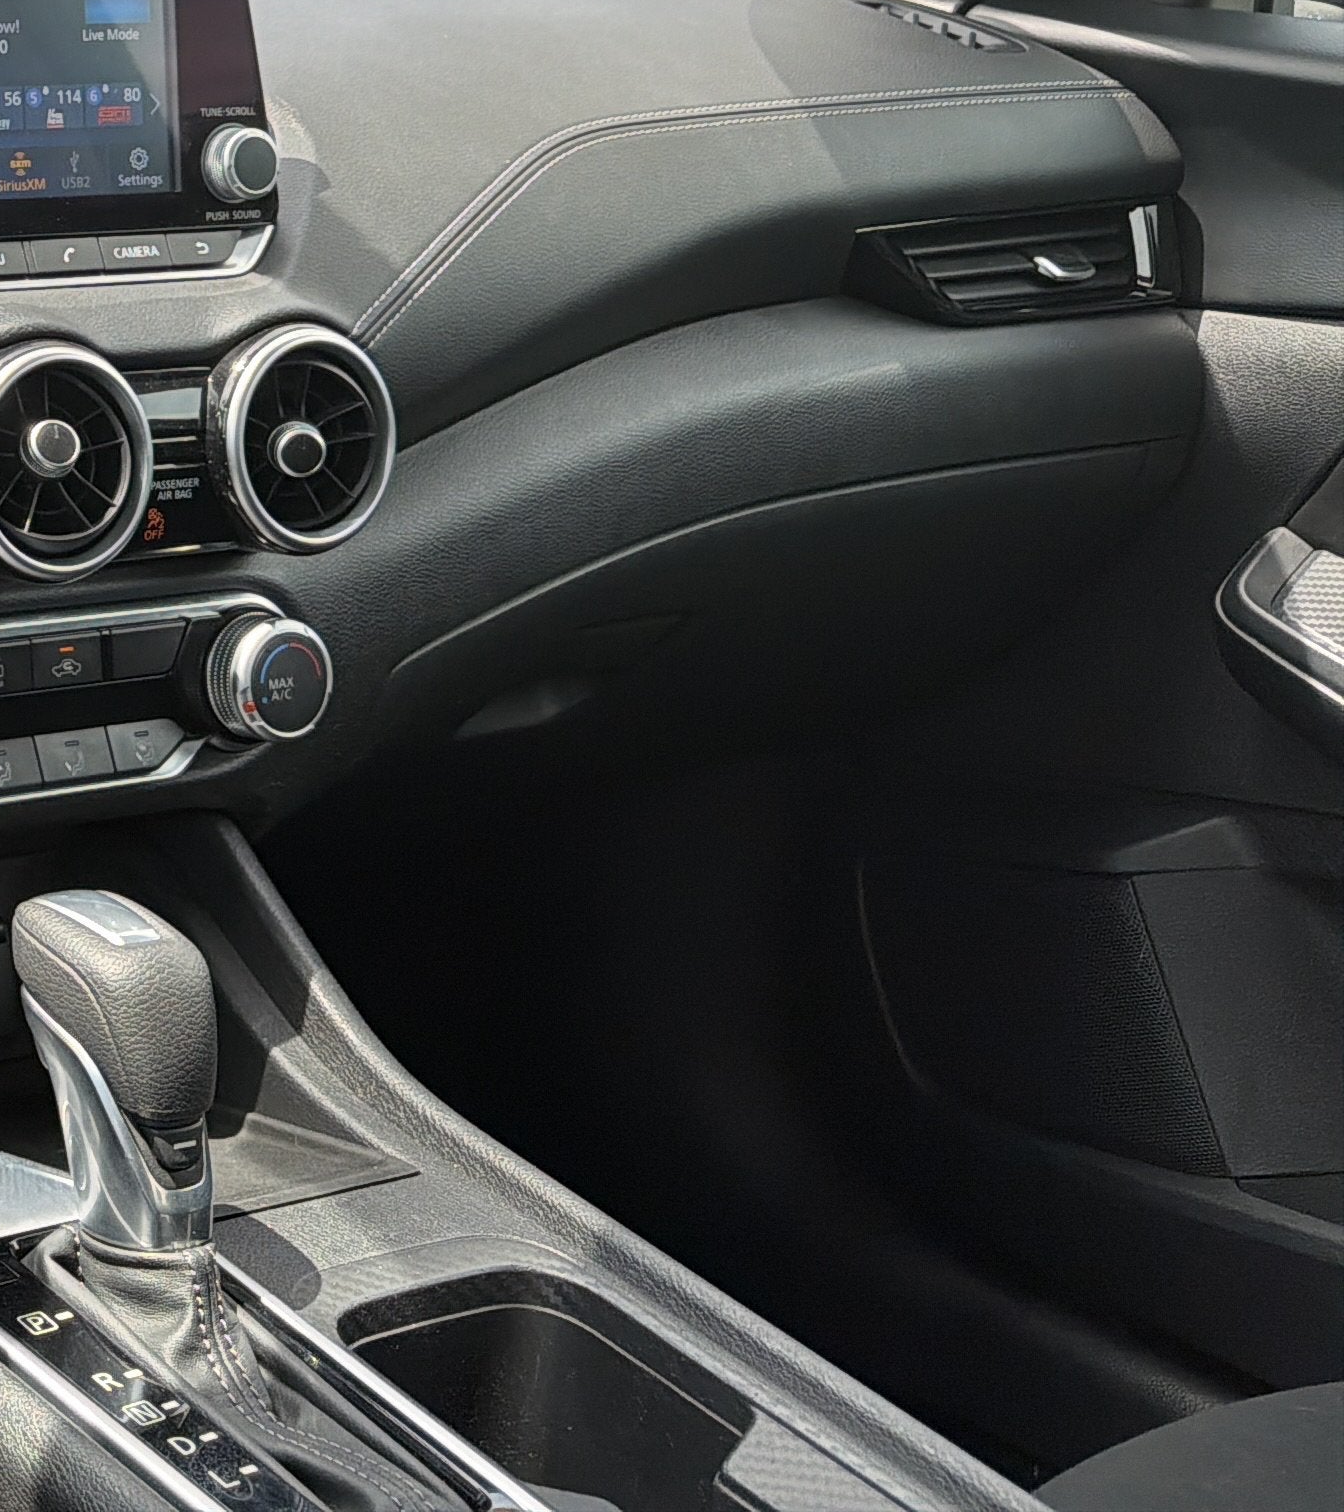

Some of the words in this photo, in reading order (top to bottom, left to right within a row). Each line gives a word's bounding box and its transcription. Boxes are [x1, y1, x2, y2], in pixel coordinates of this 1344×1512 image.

[82, 29, 105, 42] Live
[107, 28, 140, 41] Mode
[4, 91, 22, 107] 56
[57, 89, 82, 105] 114
[123, 87, 141, 103] 80
[62, 176, 91, 189] USB2
[117, 173, 163, 188] Settings
[205, 210, 230, 222] PUSH
[232, 208, 262, 220] SOUND
[113, 244, 160, 260] CAMERA
[151, 477, 200, 490] PASSENGER
[157, 490, 173, 501] AIR
[174, 488, 193, 500] BAG
[143, 529, 165, 541] OFF
[268, 676, 295, 690] MAX
[271, 688, 293, 702] A/C
[28, 1315, 48, 1331] P
[91, 1371, 124, 1392] R
[136, 1404, 157, 1422] N
[167, 1436, 196, 1456] D
[207, 1468, 241, 1488] L
